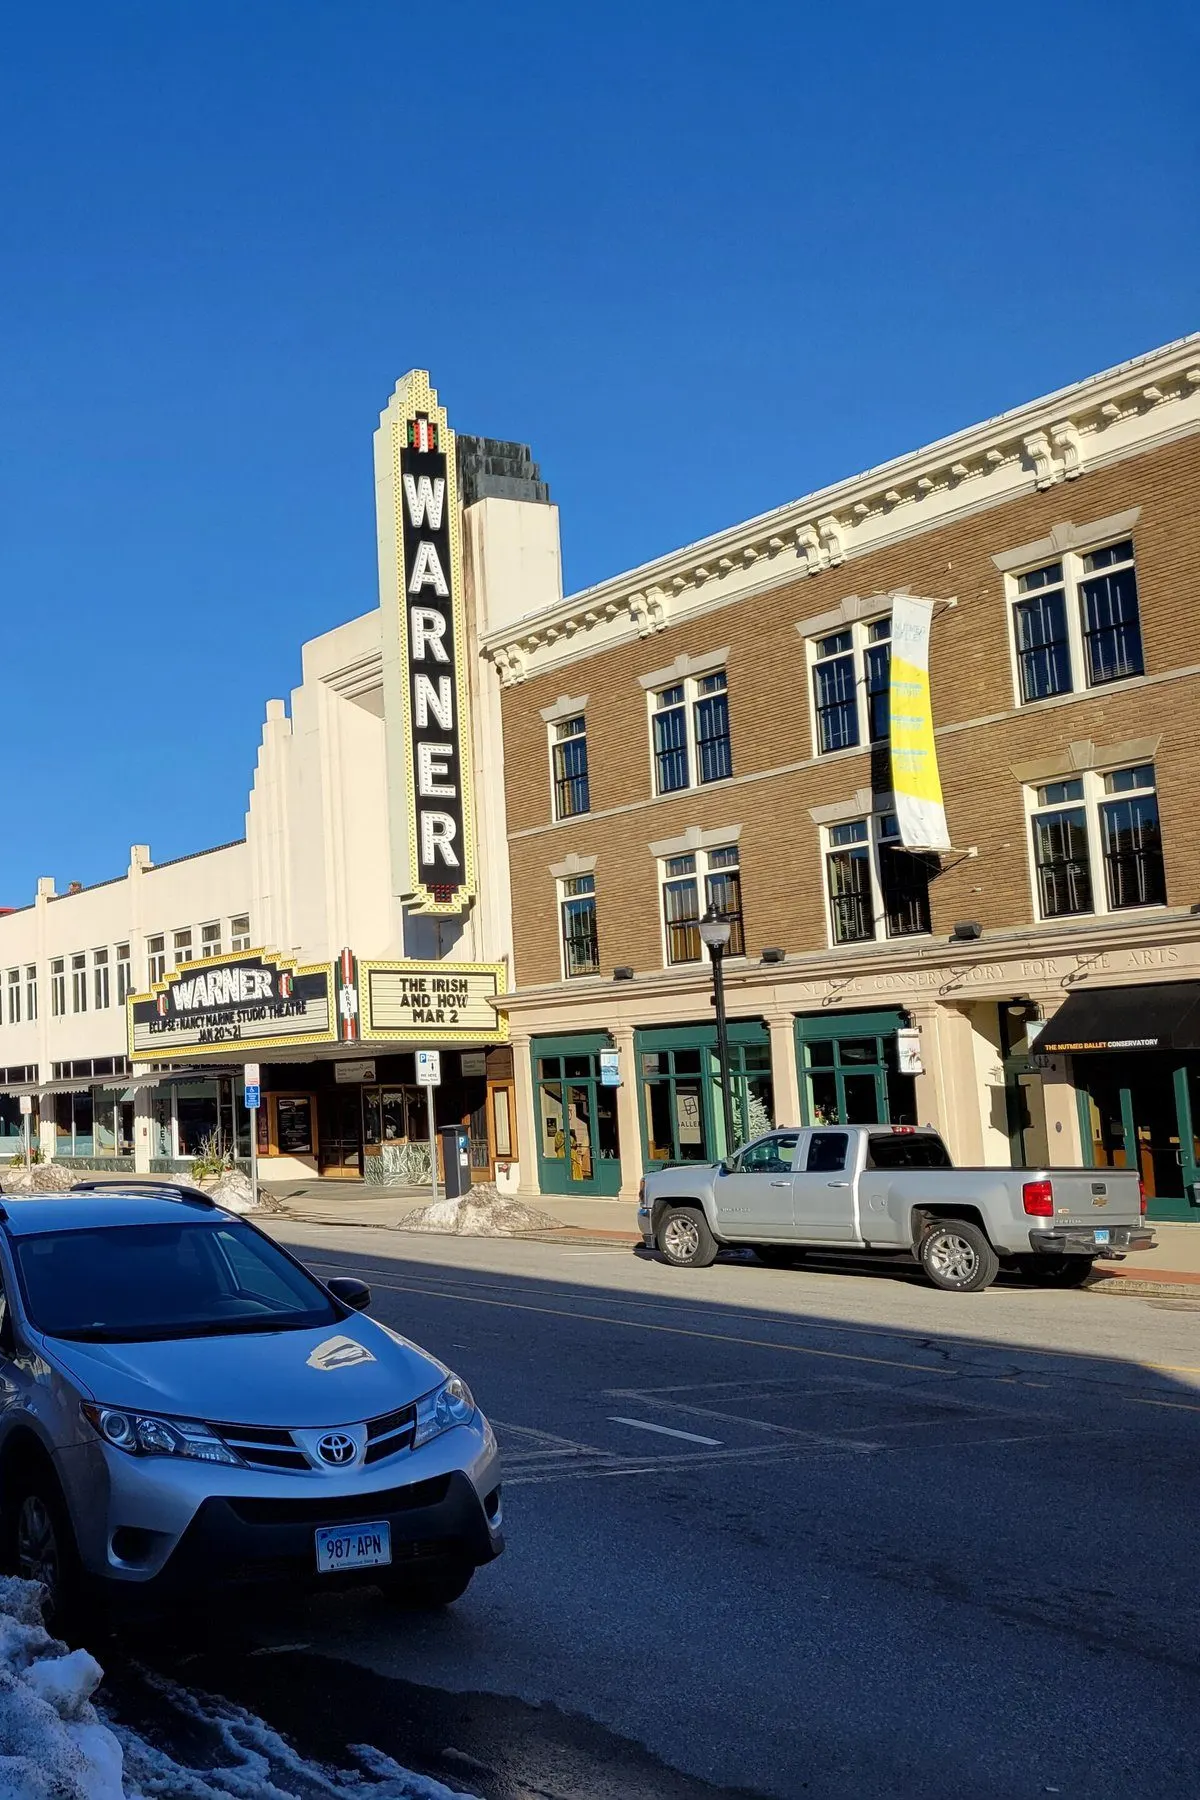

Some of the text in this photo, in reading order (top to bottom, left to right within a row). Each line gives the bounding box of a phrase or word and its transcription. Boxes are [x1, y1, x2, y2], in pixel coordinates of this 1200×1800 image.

[403, 472, 460, 868] WARNER
[1020, 959, 1058, 977] FOR
[1127, 947, 1179, 967] ARTS
[172, 967, 274, 1011] WARNER
[399, 978, 468, 993] THE IRISH
[399, 994, 469, 1009] AND HOW
[149, 1000, 308, 1034] ECLIPSE NANCY MARINE STUDIO THEATRE
[412, 1009, 459, 1023] MAR 2
[198, 1028, 213, 1042] JAN
[214, 1026, 224, 1041] 20
[233, 1024, 241, 1039] 21
[1057, 1042, 1083, 1051] NUTMEG
[1084, 1041, 1107, 1049] BALLET
[1108, 1038, 1158, 1048] CONSERVATORY
